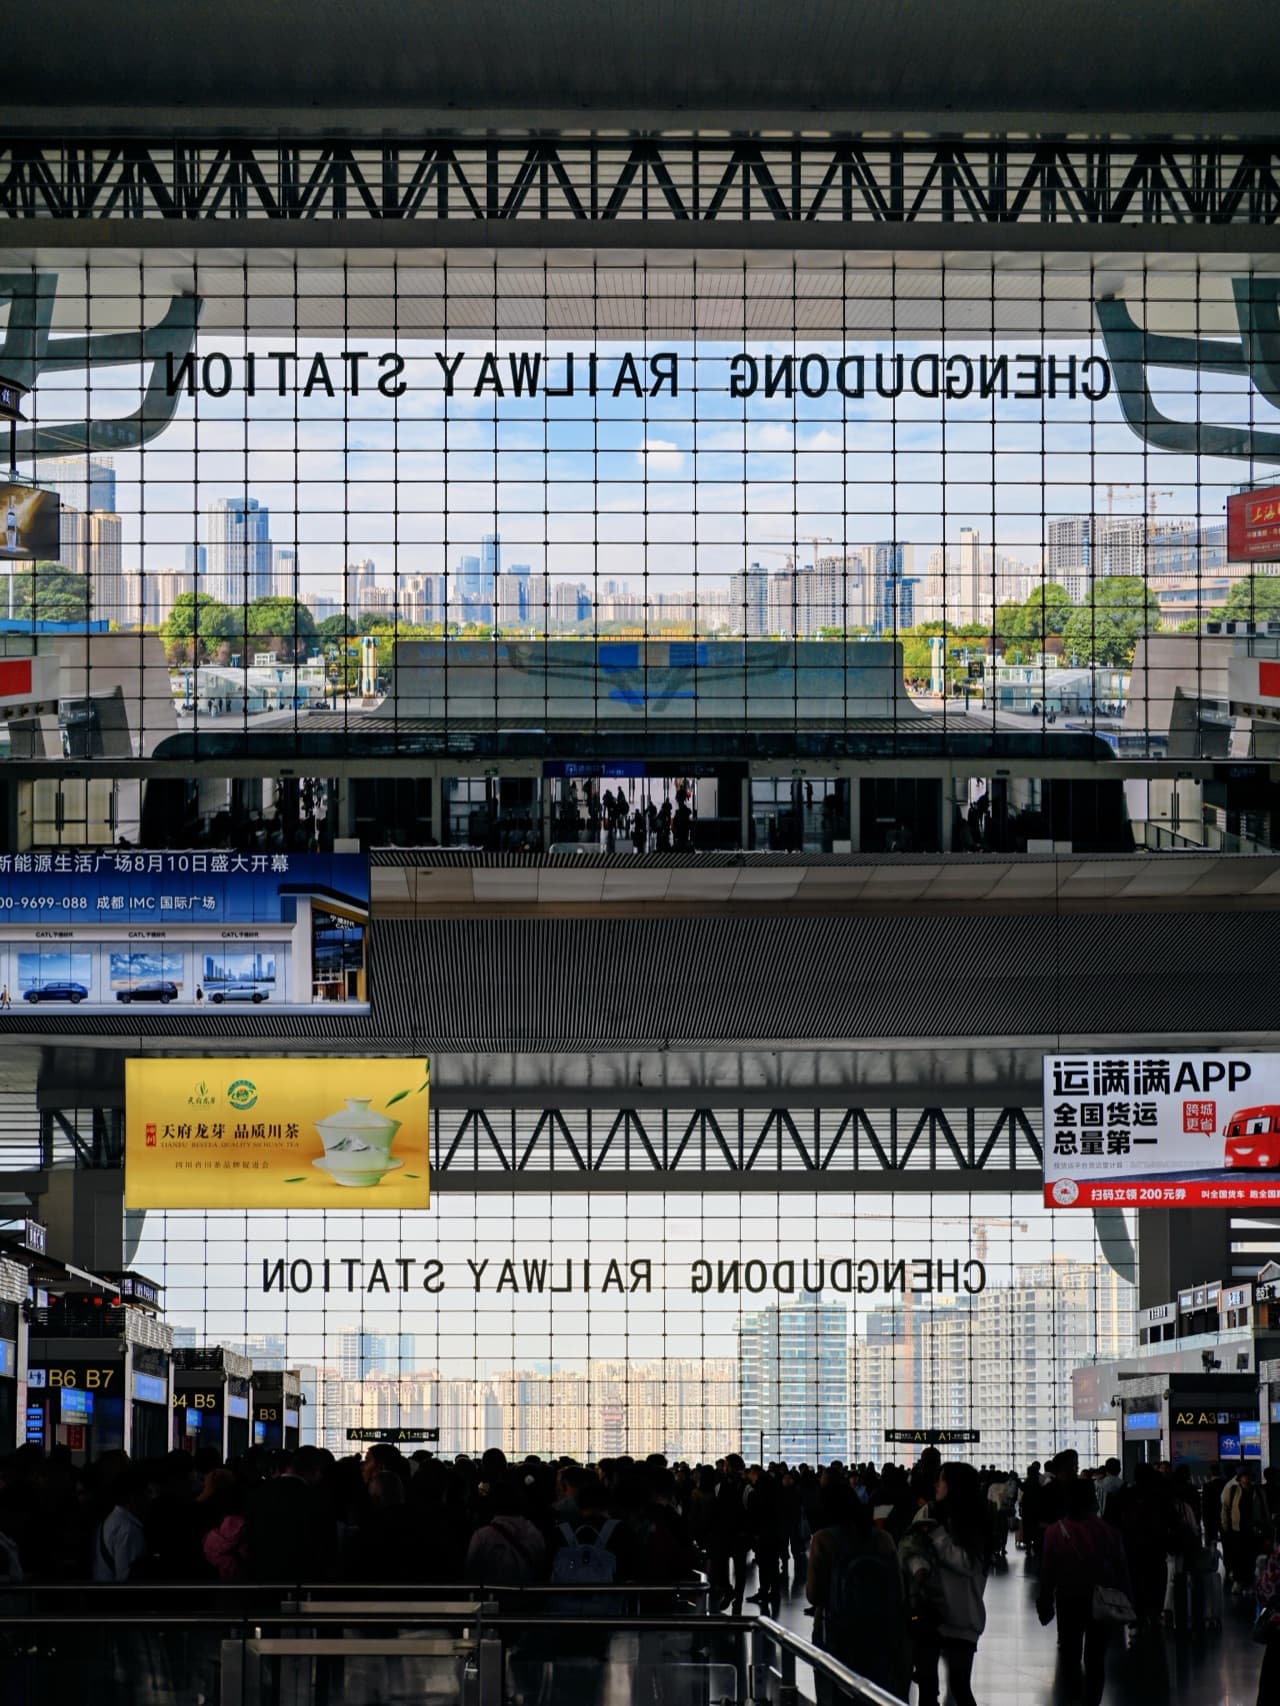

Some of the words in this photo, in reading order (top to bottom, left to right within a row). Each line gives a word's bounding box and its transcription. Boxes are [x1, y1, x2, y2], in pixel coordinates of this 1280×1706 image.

[96, 896, 125, 911] 成都
[129, 897, 155, 910] IMC
[160, 896, 216, 911] 国际广场
[1053, 1059, 1252, 1097] 运满满APP
[1053, 1101, 1158, 1127] 全国货运
[1185, 1103, 1214, 1117] 跨城
[162, 1123, 225, 1139] 天府龙芽
[233, 1123, 299, 1139] 品质川茶
[1185, 1117, 1214, 1131] 更省
[1053, 1130, 1158, 1155] 总量第一
[48, 1369, 77, 1388] B6
[85, 1369, 114, 1389] B7
[194, 1393, 216, 1409] B5
[259, 1408, 277, 1421] B3
[1176, 1412, 1195, 1425] A2
[1198, 1412, 1216, 1425] A3
[350, 1430, 363, 1440] A1
[398, 1430, 411, 1440] A1
[914, 1431, 927, 1441] A1
[938, 1431, 951, 1441] A1
